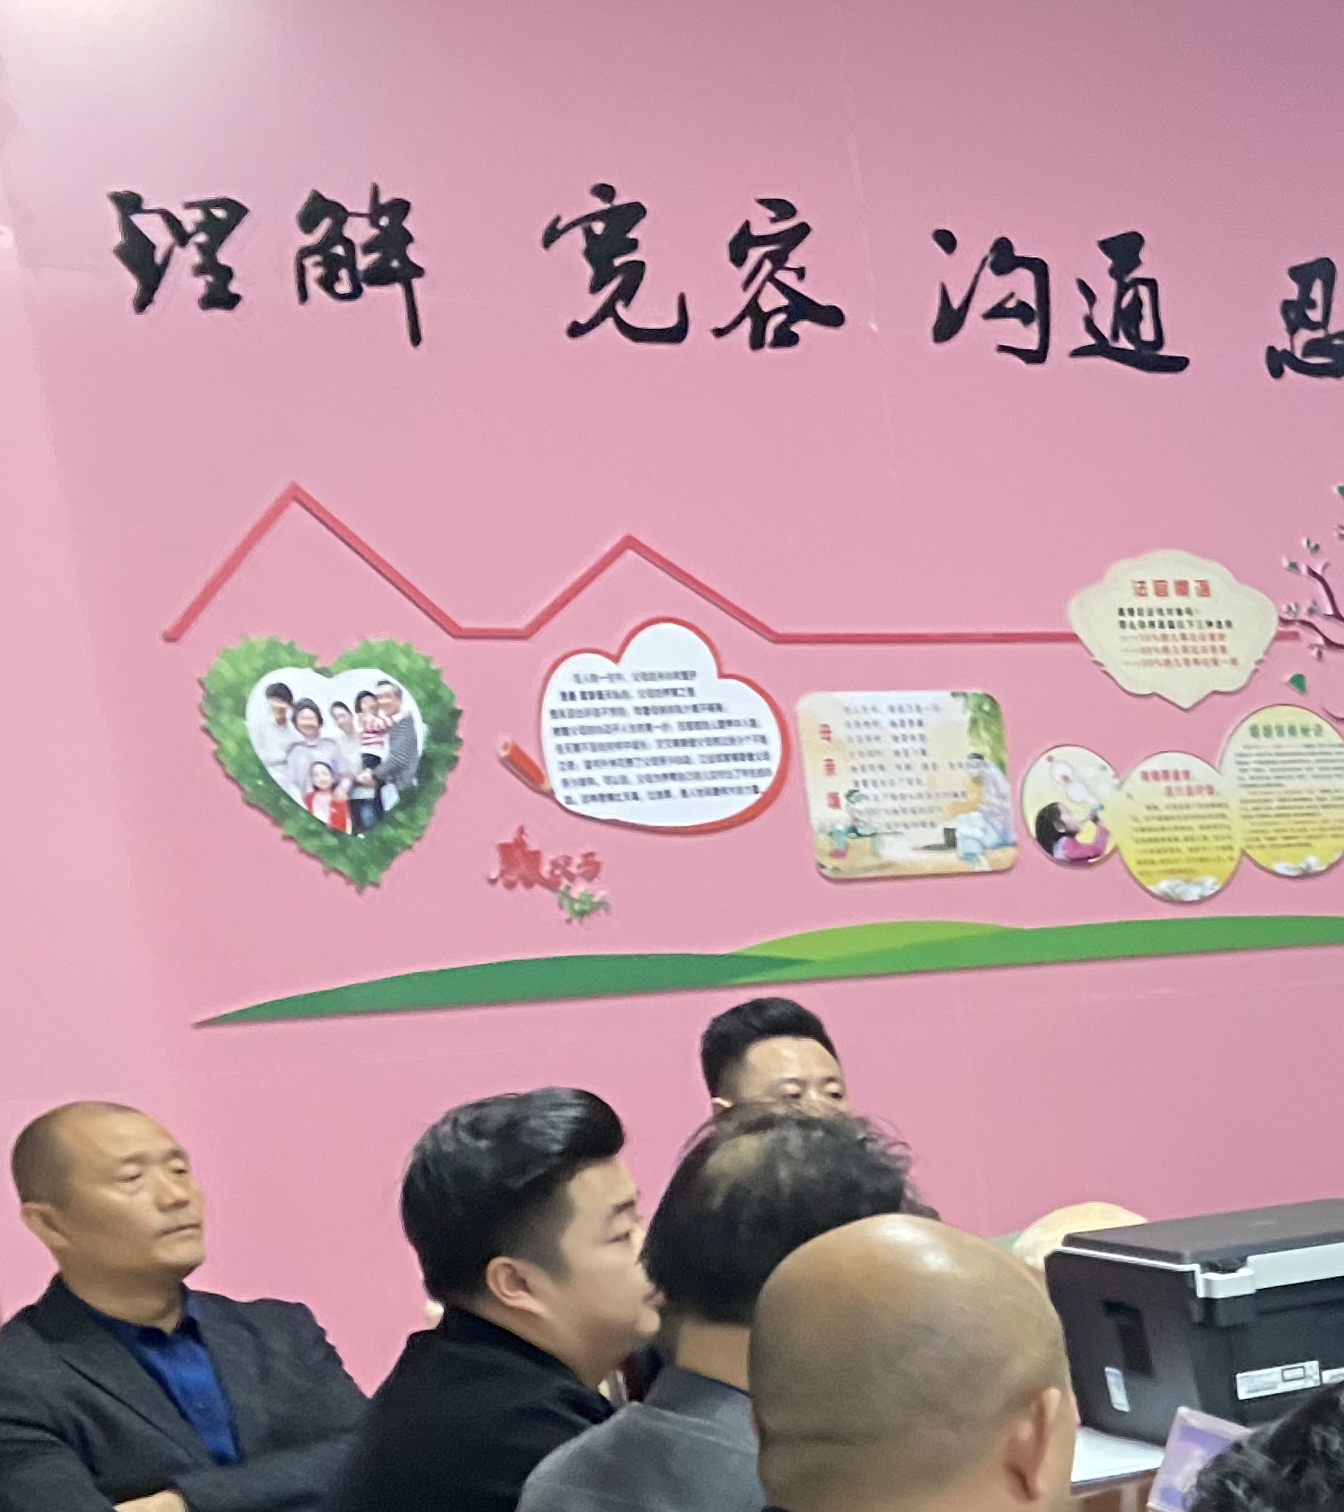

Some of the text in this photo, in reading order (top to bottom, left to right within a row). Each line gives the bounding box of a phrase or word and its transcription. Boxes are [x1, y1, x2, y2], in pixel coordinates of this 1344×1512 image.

[106, 183, 424, 347] 理解
[541, 182, 845, 350] 宽容
[931, 227, 1190, 374] 沟通
